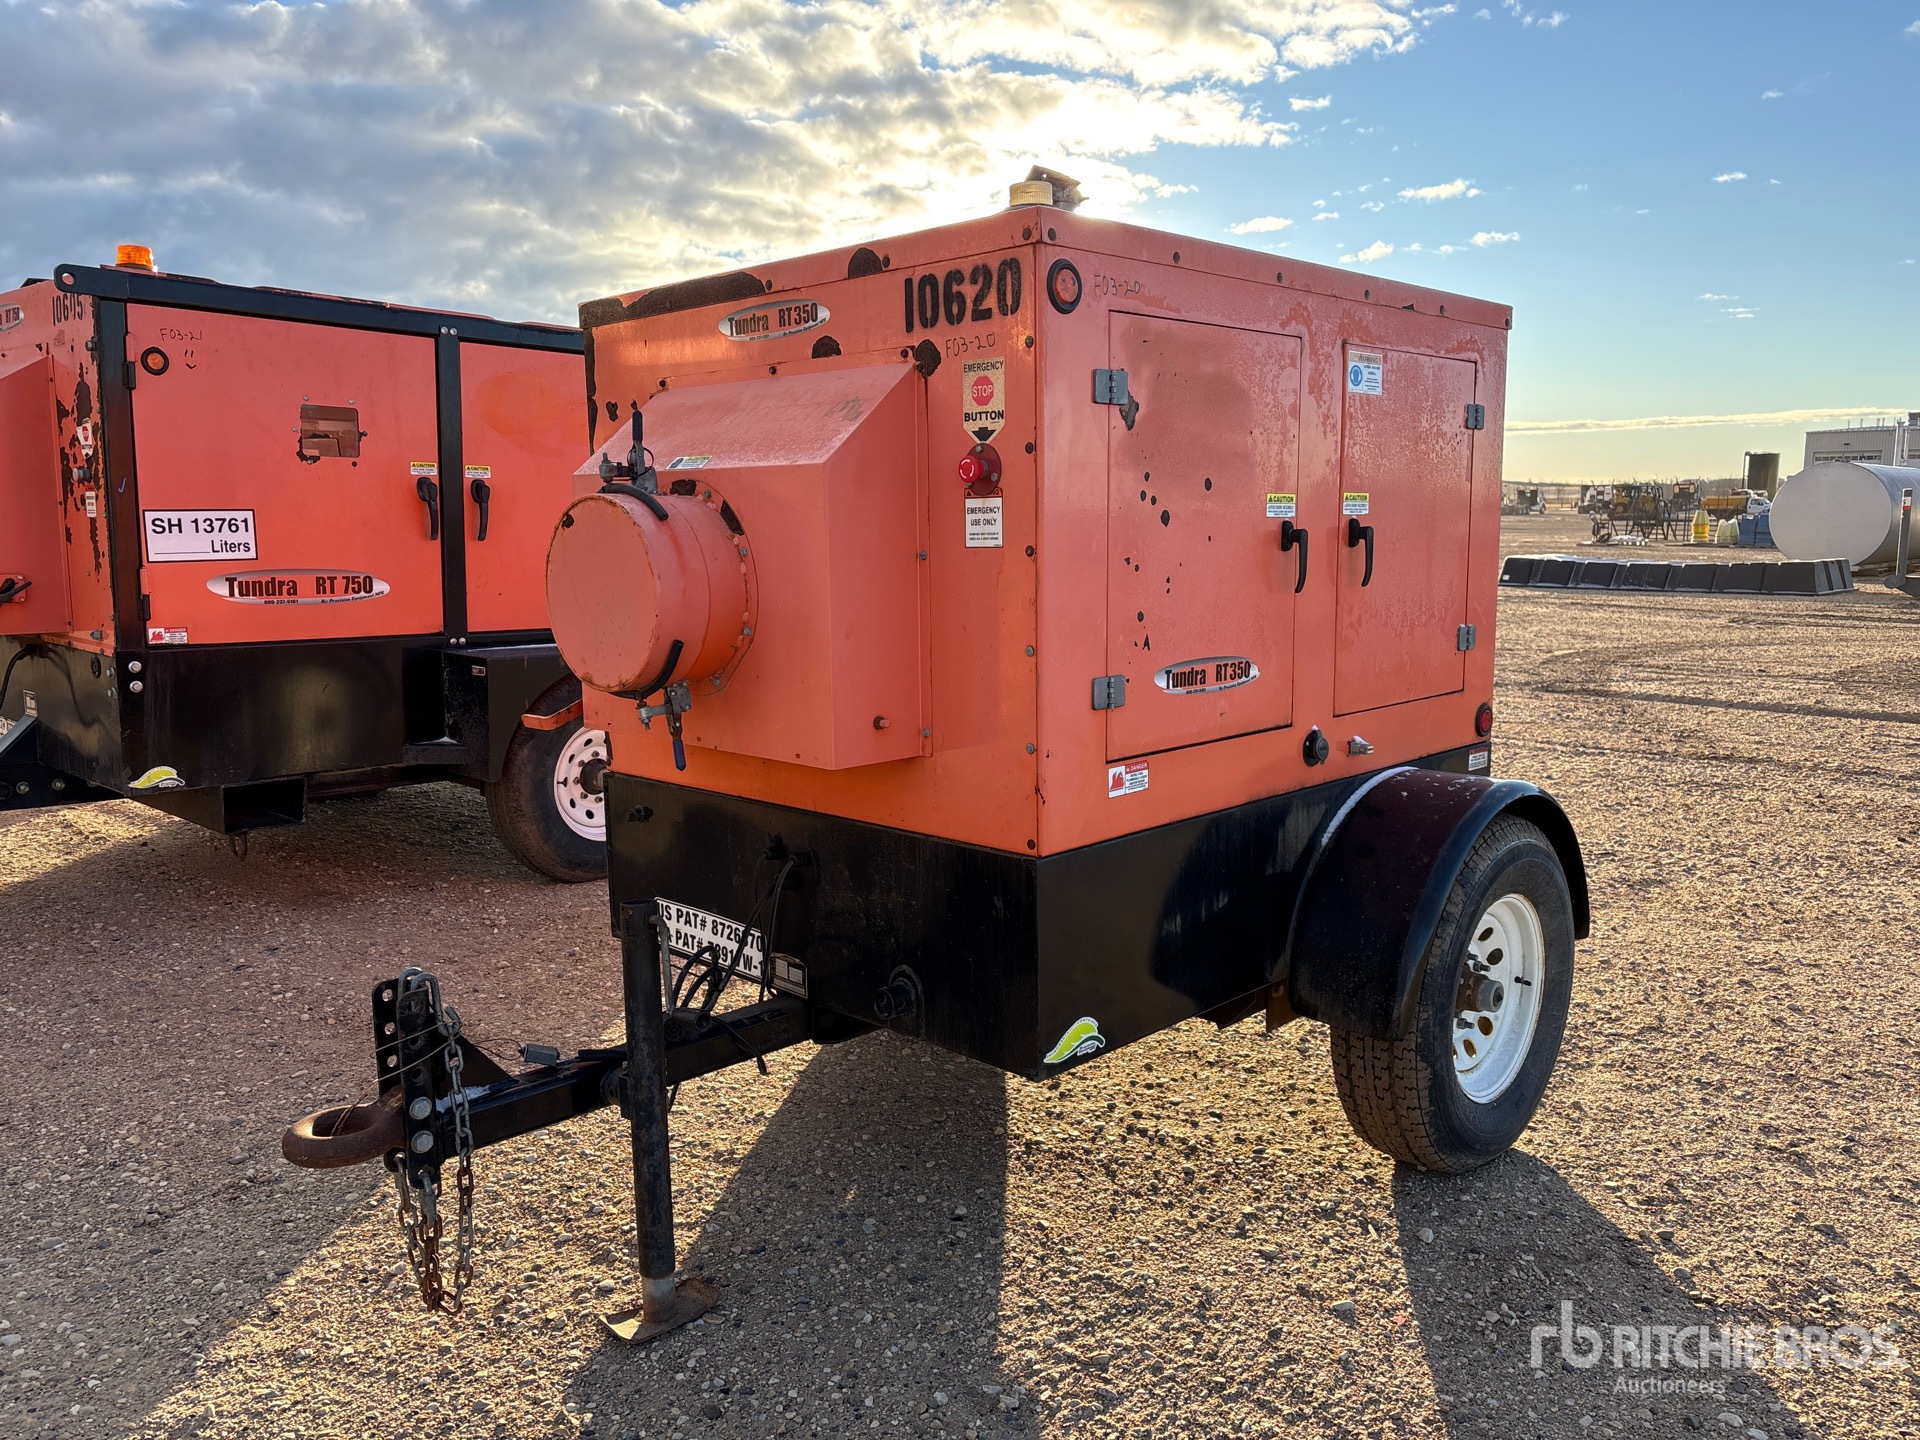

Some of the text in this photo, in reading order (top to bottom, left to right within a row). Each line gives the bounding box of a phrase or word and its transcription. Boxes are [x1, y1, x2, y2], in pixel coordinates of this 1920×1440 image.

[1094, 274, 1141, 298] F03-20
[904, 258, 1022, 333] 10620
[728, 313, 769, 337] Tundra
[160, 328, 203, 341] F03-21
[945, 332, 996, 358] F03-20
[963, 360, 1004, 373] EMERGENCY
[1359, 355, 1379, 364] WARNING
[972, 385, 993, 398] STOP
[964, 410, 1004, 422] BUTTON
[967, 506, 1000, 514] EMERGENCY
[151, 517, 249, 534] SH 13761
[983, 518, 997, 526] ONLY
[211, 539, 251, 553] Liters
[225, 575, 374, 597] Tundra RT 750
[1165, 667, 1206, 689] Tundra
[657, 902, 672, 921] US
[676, 907, 707, 932] PAT#
